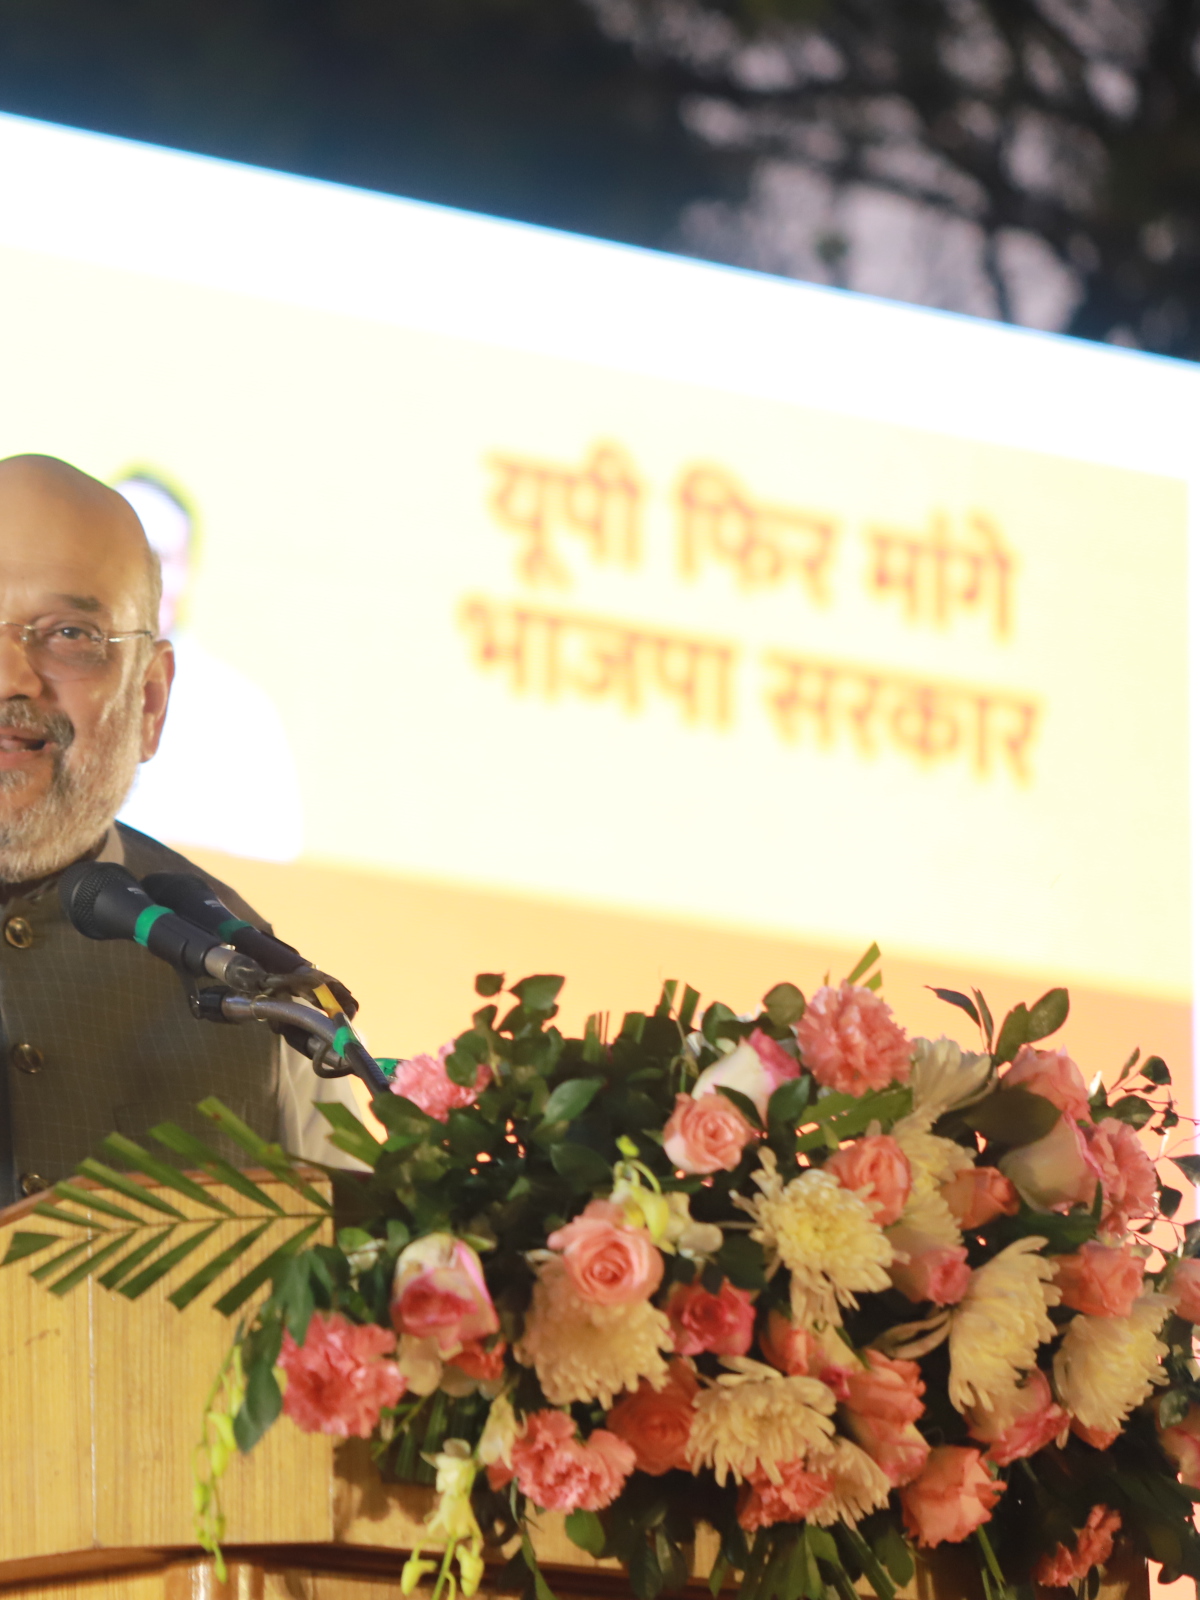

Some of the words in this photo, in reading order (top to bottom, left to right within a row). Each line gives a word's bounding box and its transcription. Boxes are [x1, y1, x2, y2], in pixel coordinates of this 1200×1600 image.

[488, 441, 646, 589] यूपी
[671, 464, 841, 606] फिर
[458, 594, 741, 730] भाजपा
[763, 649, 1045, 788] सरकार
